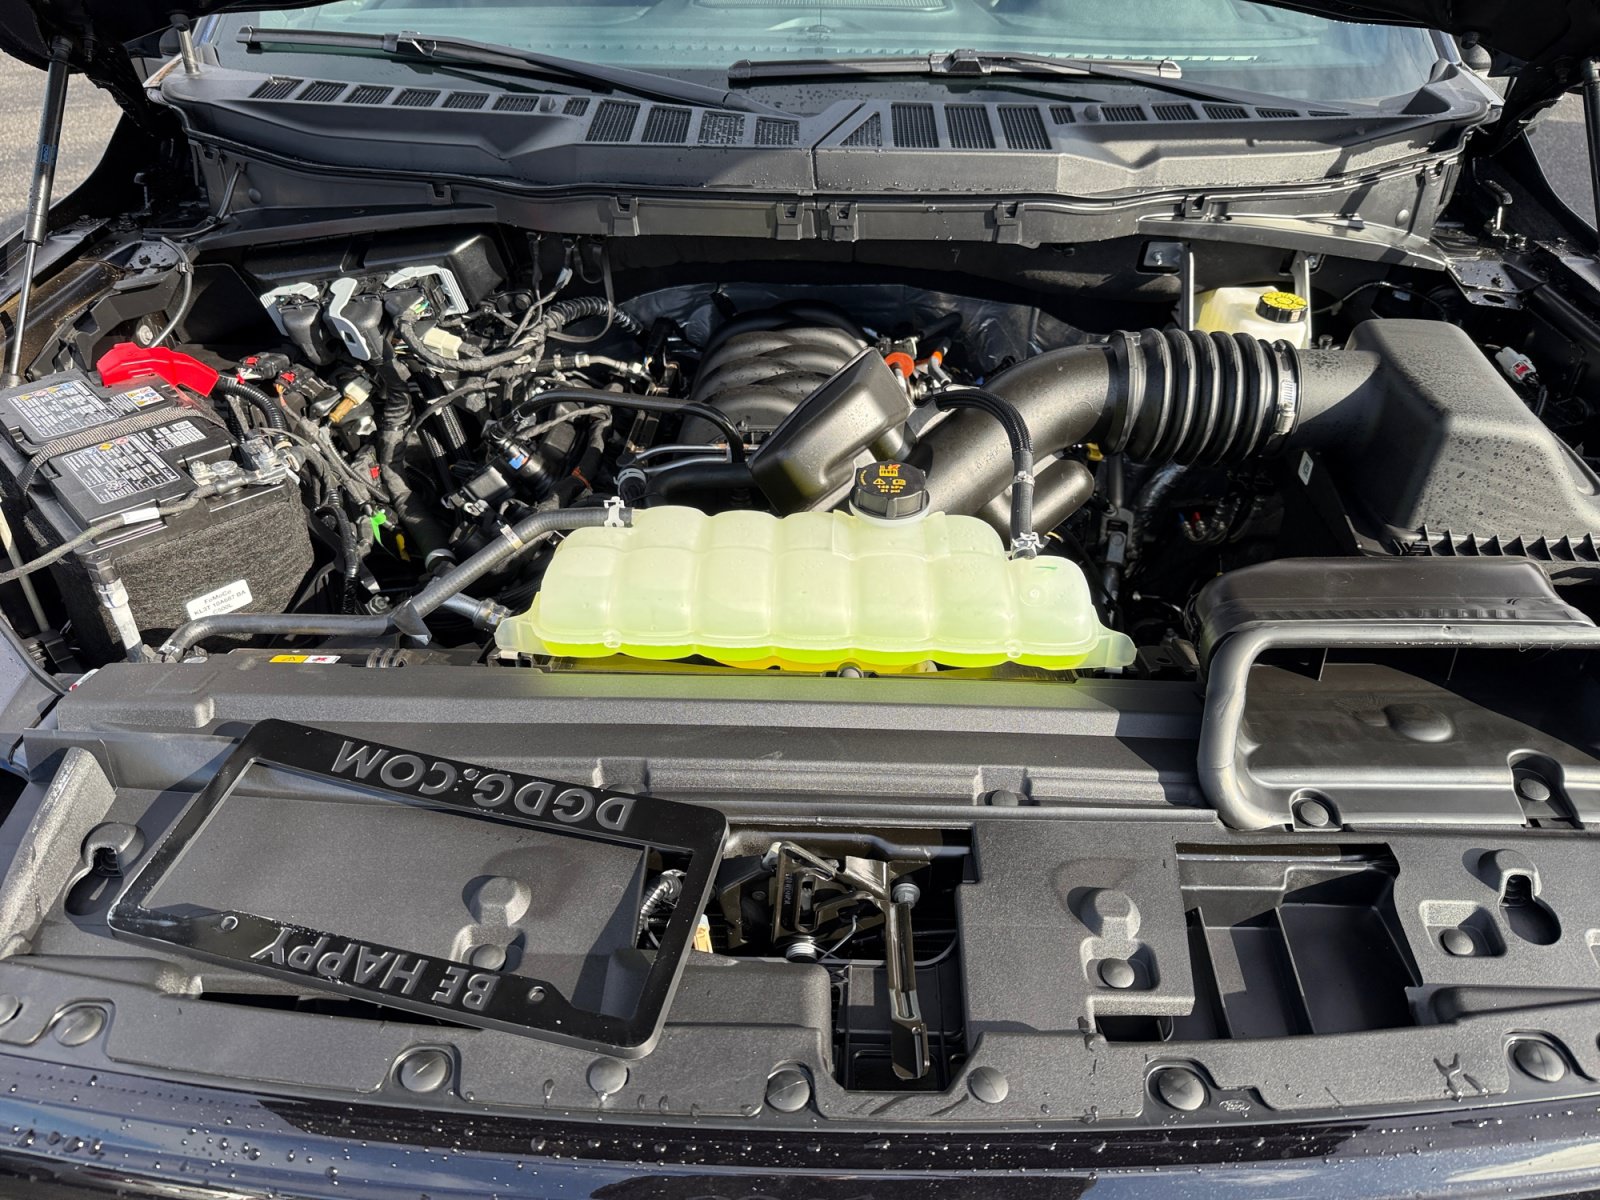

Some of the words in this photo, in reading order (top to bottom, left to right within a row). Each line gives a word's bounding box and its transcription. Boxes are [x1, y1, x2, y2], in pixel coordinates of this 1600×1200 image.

[204, 589, 232, 604] FoMoCo
[331, 740, 637, 832] DGDG.COM
[250, 927, 429, 996] HAPPY
[431, 965, 501, 1011] BE
